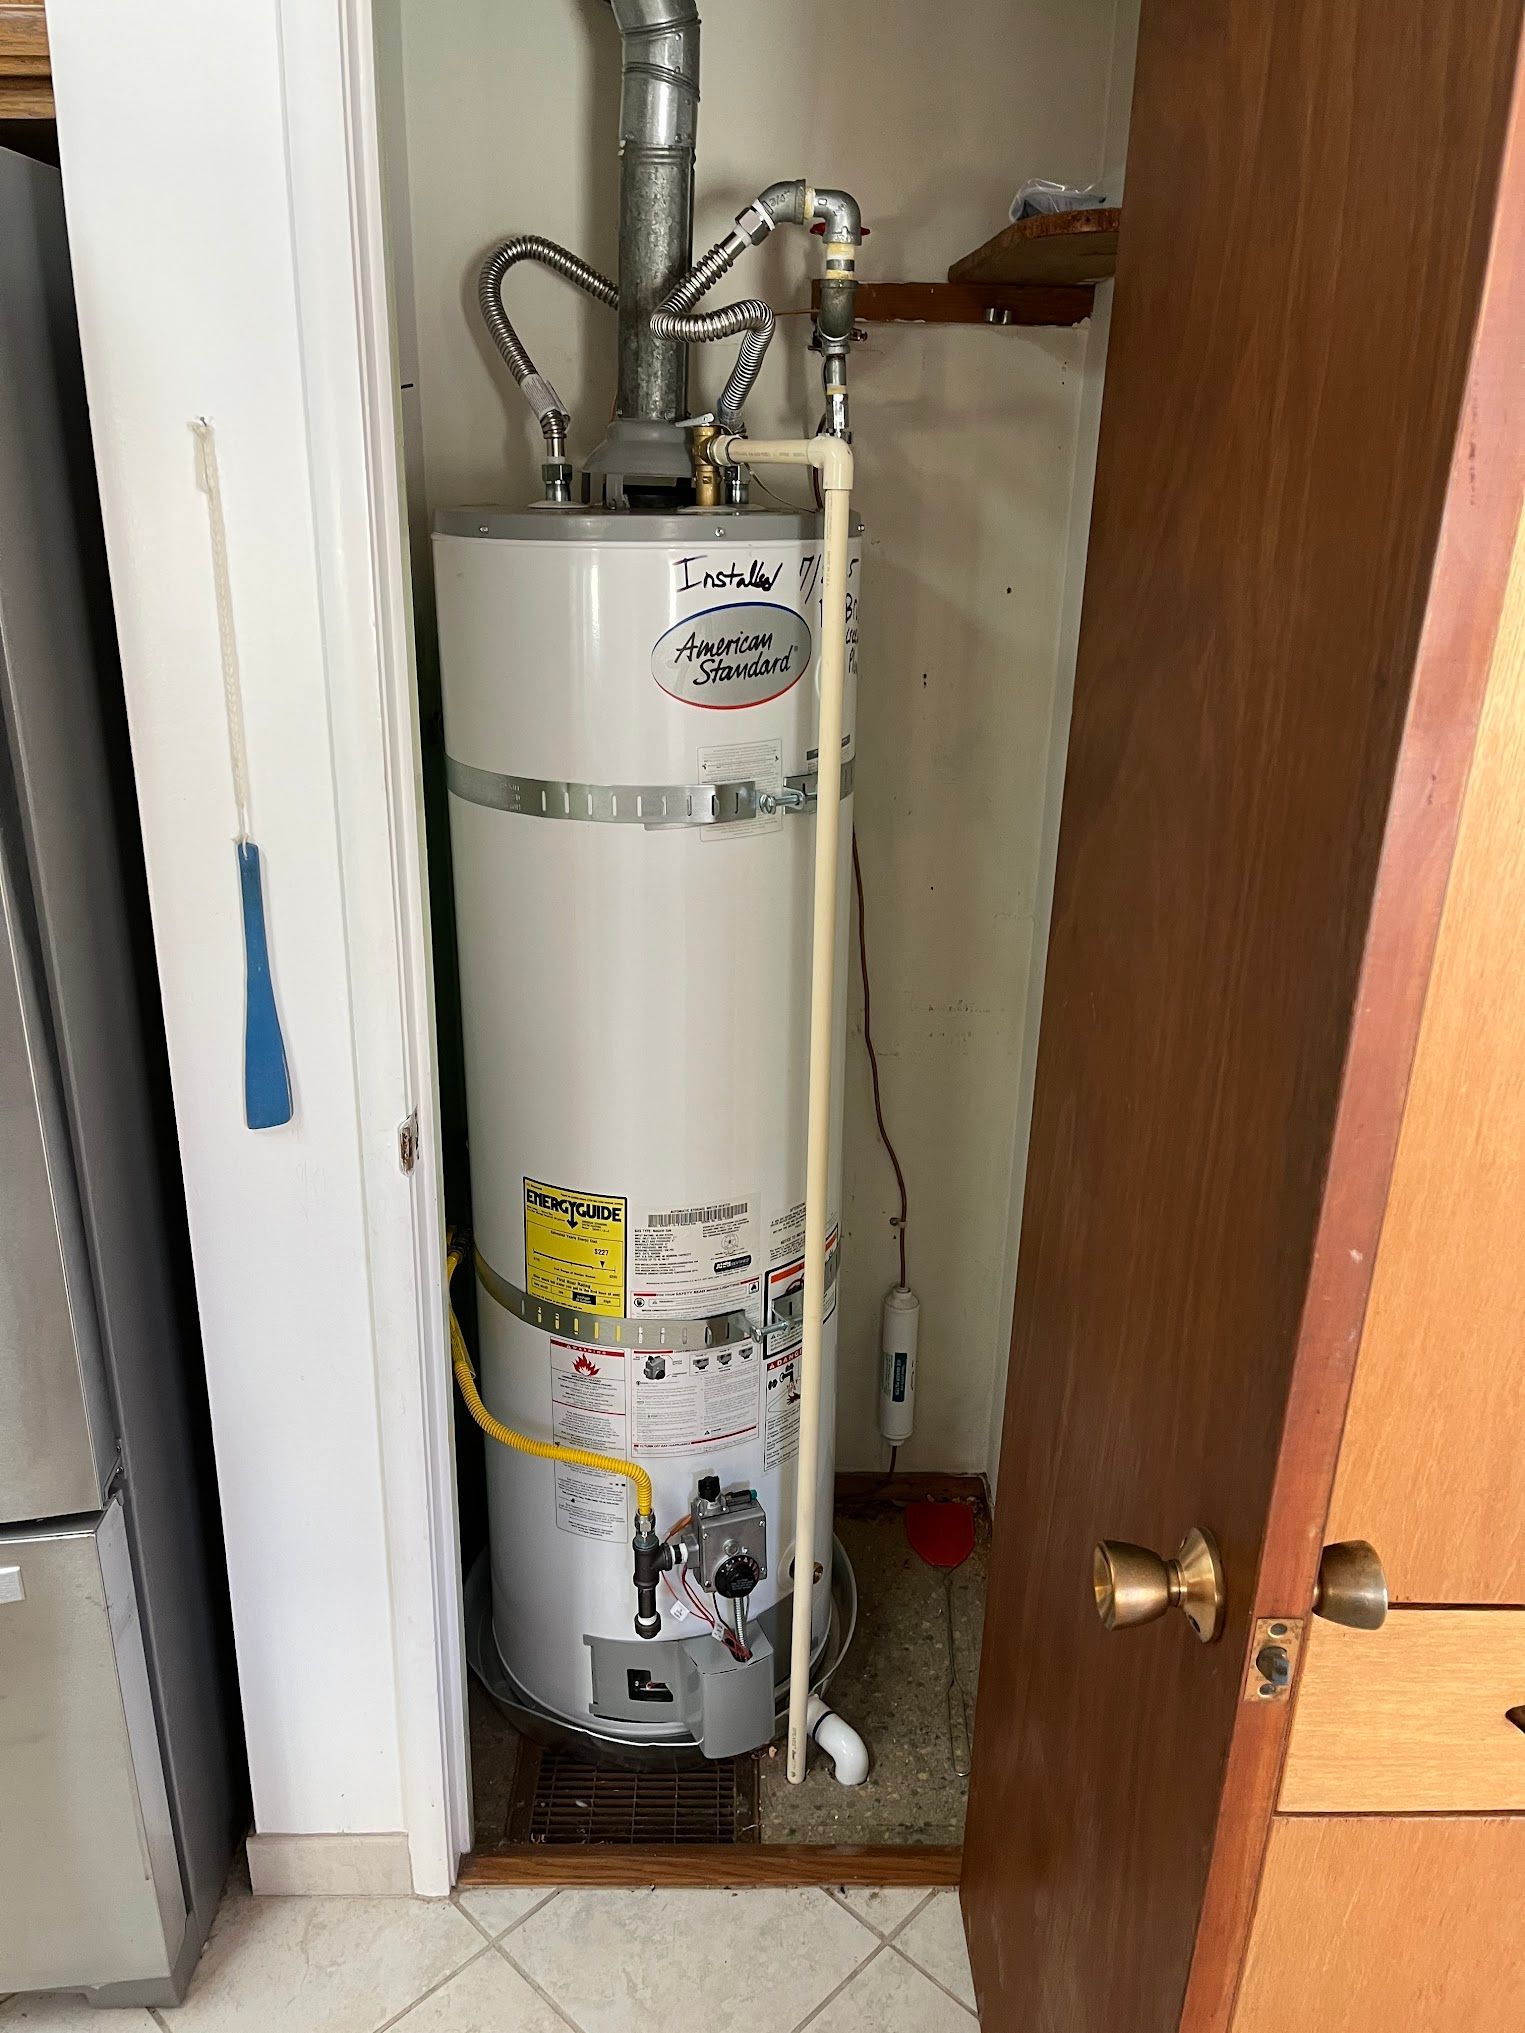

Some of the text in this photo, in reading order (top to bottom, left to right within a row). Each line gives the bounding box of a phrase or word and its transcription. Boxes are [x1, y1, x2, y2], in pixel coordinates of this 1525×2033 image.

[674, 631, 773, 664] American
[693, 645, 793, 686] Standard
[527, 1189, 622, 1224] ENERGYGUIDE
[594, 1248, 609, 1256] $227
[777, 1348, 802, 1366] DANG
